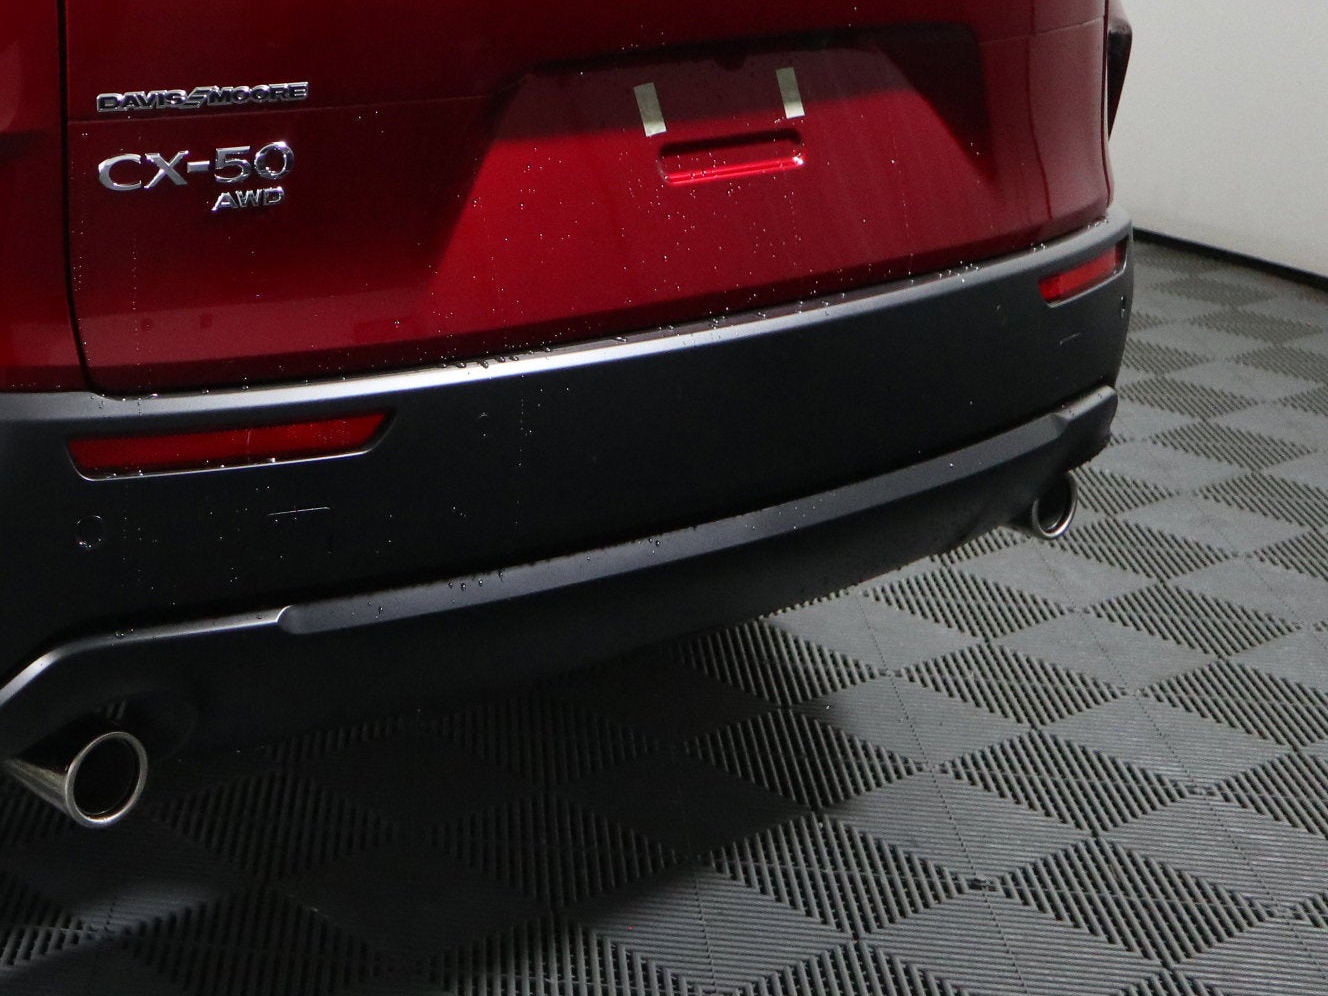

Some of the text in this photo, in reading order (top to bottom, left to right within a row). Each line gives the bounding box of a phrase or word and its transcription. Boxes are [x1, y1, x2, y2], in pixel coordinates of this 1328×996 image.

[96, 81, 310, 113] DAVIS MOORE
[97, 140, 295, 192] CX-50
[211, 185, 286, 212] AWD
